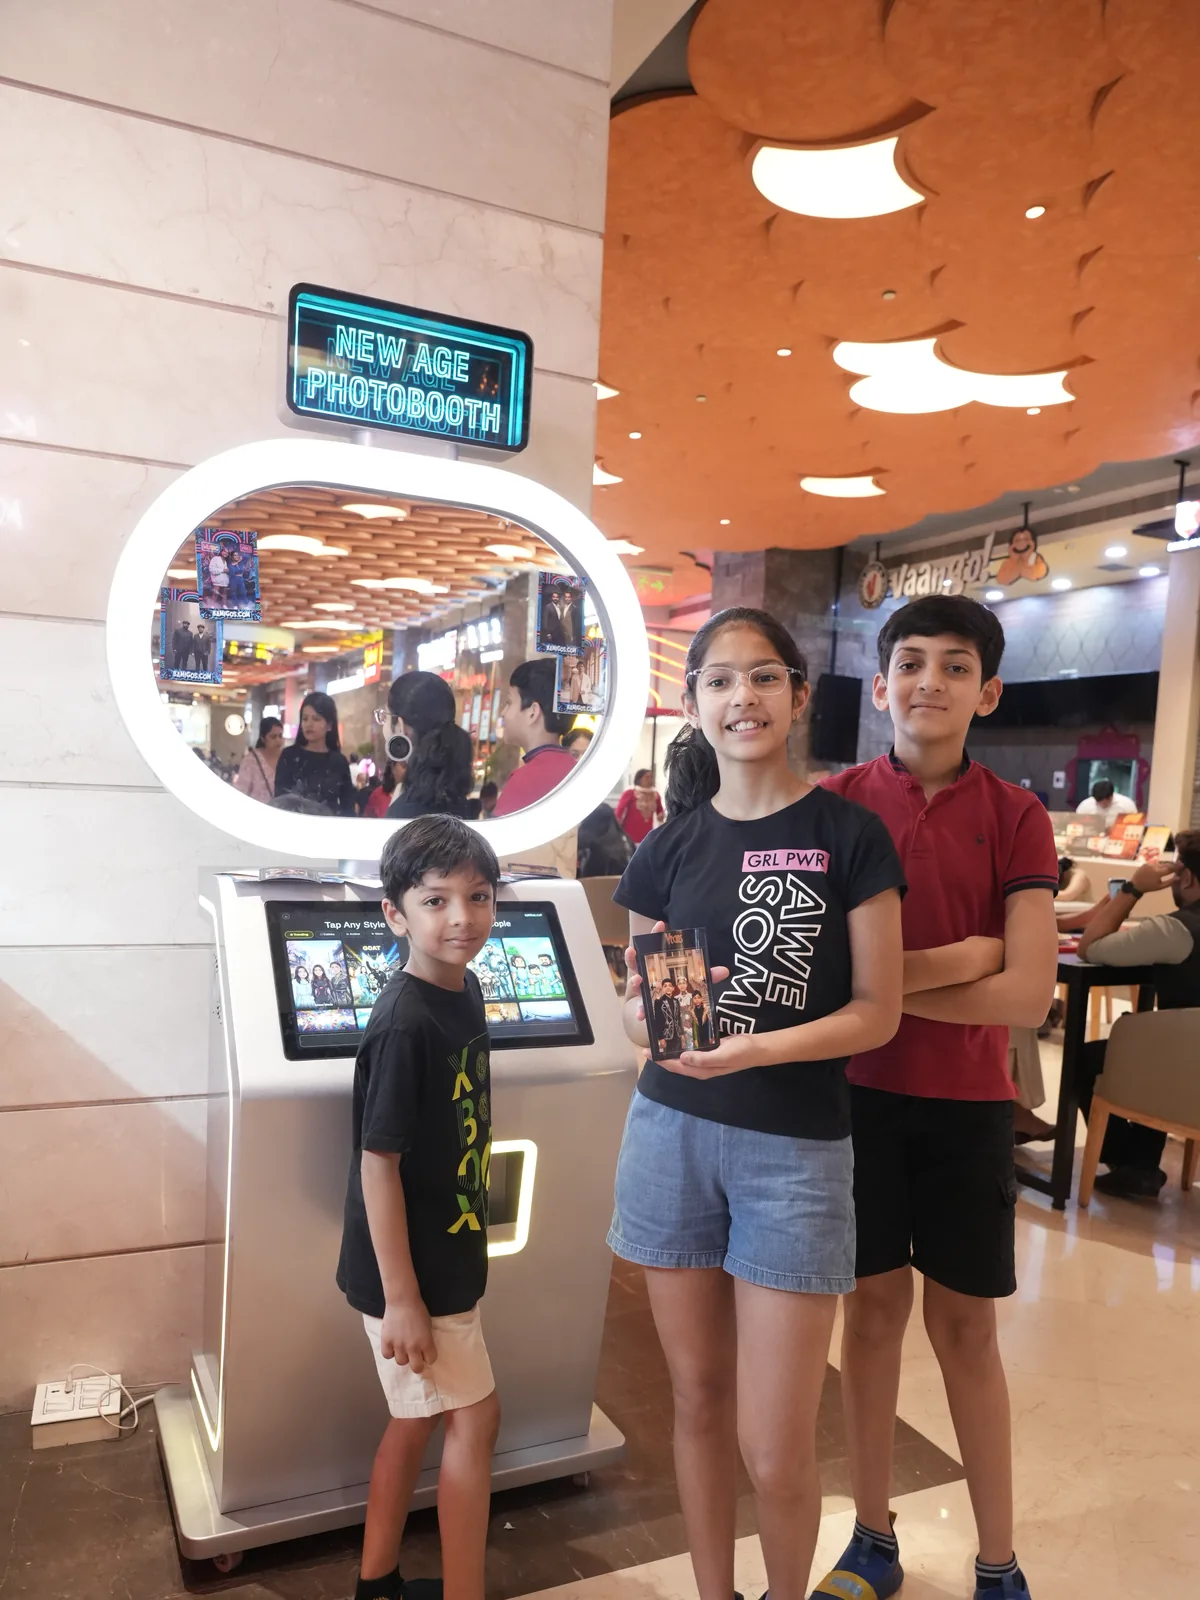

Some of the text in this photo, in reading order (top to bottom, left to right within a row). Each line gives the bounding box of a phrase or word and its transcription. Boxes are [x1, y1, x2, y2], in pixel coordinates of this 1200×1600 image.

[336, 325, 470, 382] NEW AGE
[307, 367, 501, 434] PHOTOBOOTH
[748, 852, 825, 868] GRL PWR
[324, 920, 512, 930] Tap Any Style ople
[716, 874, 783, 1035] SOME
[765, 873, 826, 1010] AWE
